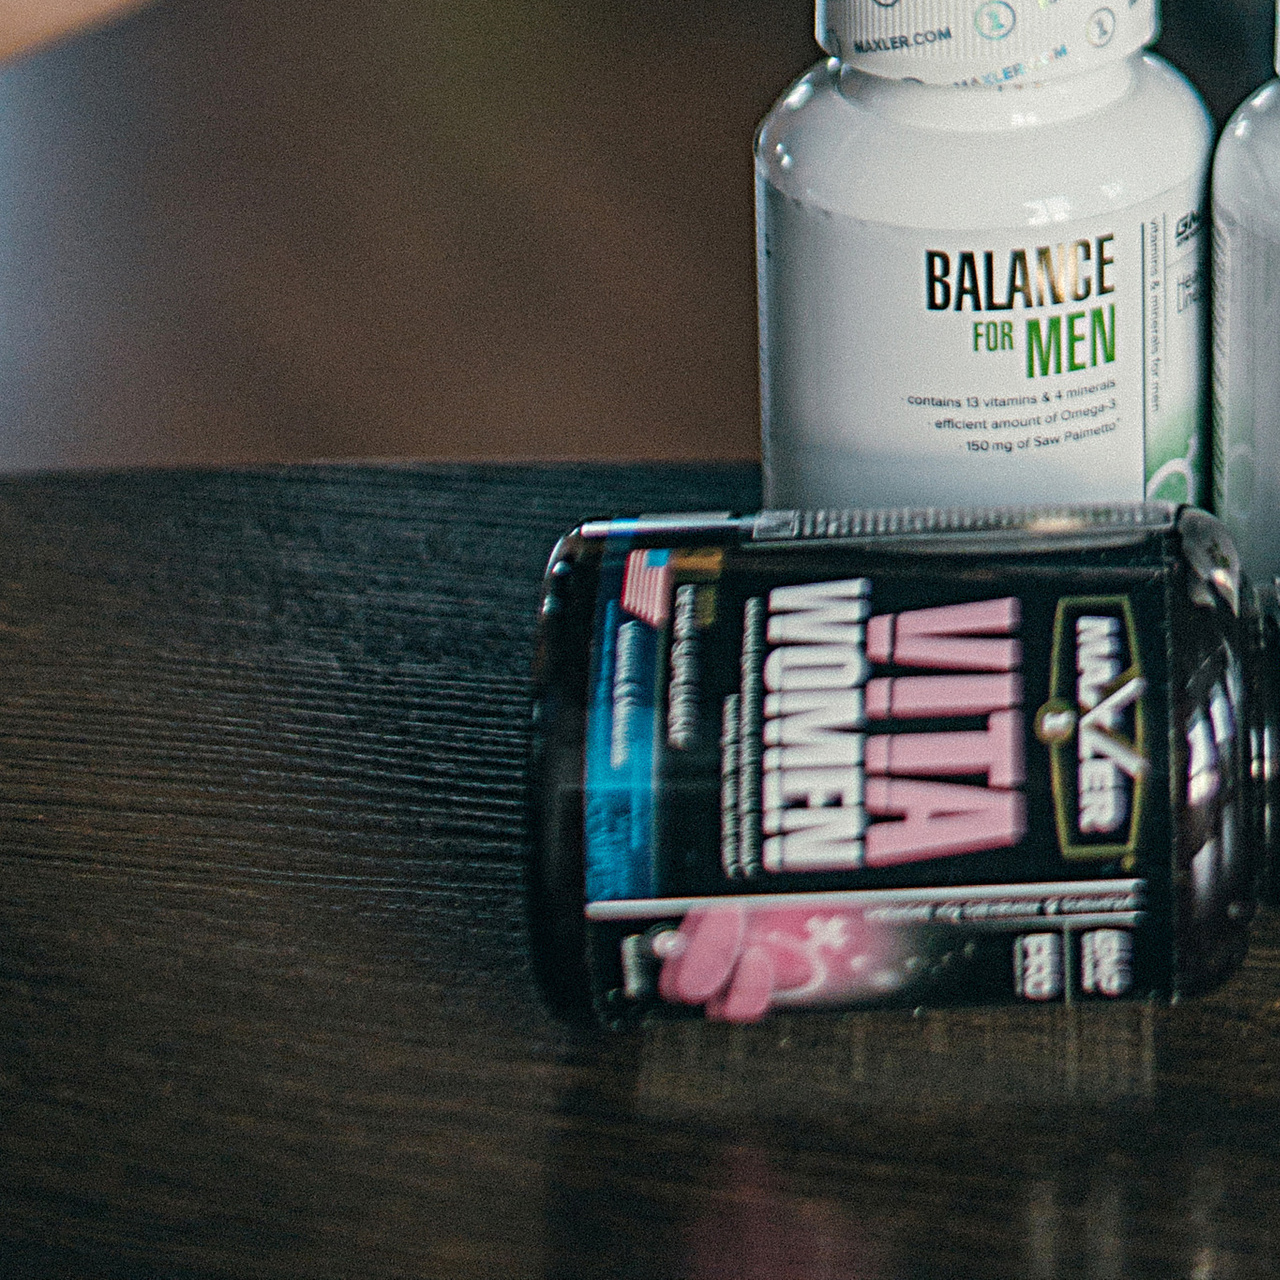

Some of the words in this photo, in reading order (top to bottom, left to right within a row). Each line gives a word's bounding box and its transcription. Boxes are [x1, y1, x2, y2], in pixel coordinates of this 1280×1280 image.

[854, 26, 952, 54] MAXLER.COM
[1150, 220, 1160, 277] vitamins
[925, 232, 1115, 312] BALANCE
[1150, 280, 1161, 291] &
[1150, 294, 1160, 355] minerals
[973, 320, 1014, 352] FOR
[1026, 303, 1116, 379] MEN
[1151, 357, 1161, 379] for
[907, 395, 961, 408] contains
[966, 396, 979, 408] 13
[983, 395, 1037, 408] vitamins
[1041, 391, 1051, 403] &
[1055, 390, 1063, 401] 4
[1066, 378, 1116, 399] minerals
[1151, 383, 1160, 412] men
[934, 417, 987, 430] efficient
[991, 417, 1041, 430] amount
[1045, 413, 1058, 425] of
[1061, 398, 1117, 421] Omega-3
[966, 440, 988, 452] 150
[992, 441, 1013, 453] mg
[1017, 438, 1030, 450] of
[1034, 434, 1060, 448] Saw
[762, 578, 871, 873] WOMEN
[865, 596, 1027, 869] VITA
